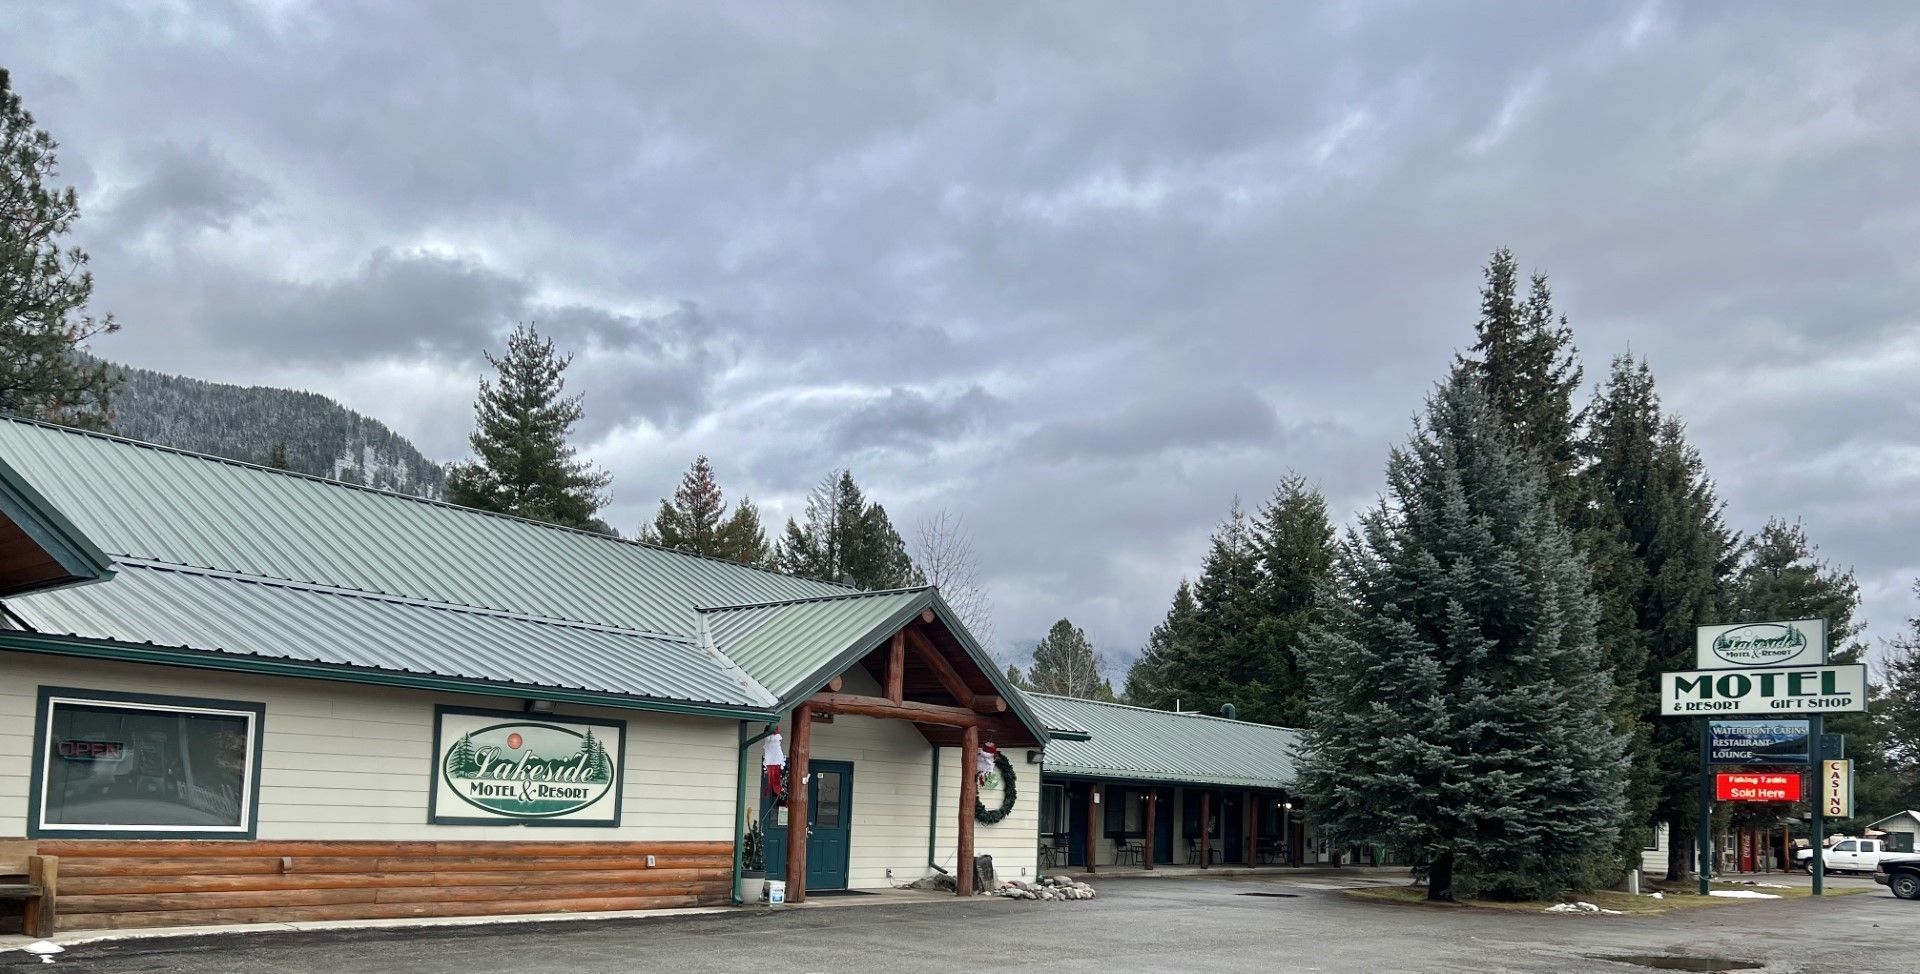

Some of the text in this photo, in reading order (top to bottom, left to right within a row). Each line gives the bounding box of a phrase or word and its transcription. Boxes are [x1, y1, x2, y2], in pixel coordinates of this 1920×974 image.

[1727, 634, 1794, 651] Lakeside
[1751, 651, 1760, 659] &
[1675, 671, 1851, 700] MOTEL
[1674, 697, 1852, 711] & RESORT GIFT SHOP
[1712, 726, 1807, 735] WATERFRONT CABINS
[59, 742, 118, 757] OPEN
[471, 745, 595, 783] Lakeside
[1728, 776, 1758, 785] Fishing
[518, 779, 537, 803] &
[1730, 788, 1786, 798] Sold Here
[1830, 762, 1841, 815] CASINO
